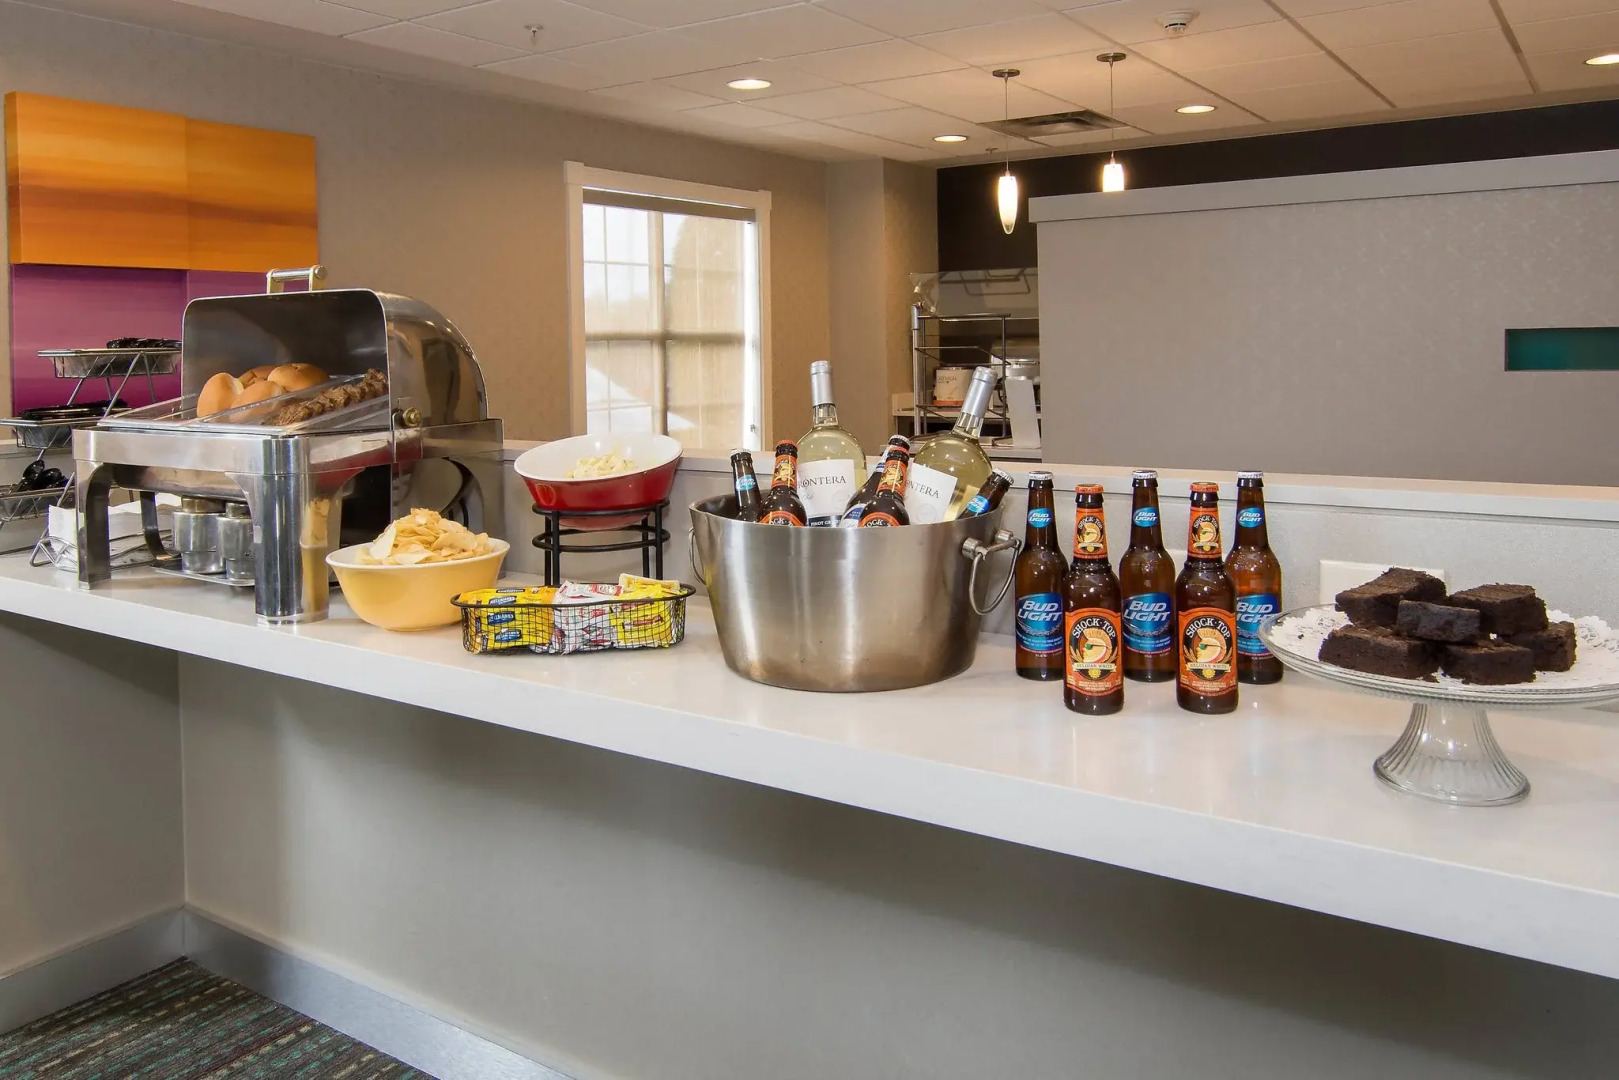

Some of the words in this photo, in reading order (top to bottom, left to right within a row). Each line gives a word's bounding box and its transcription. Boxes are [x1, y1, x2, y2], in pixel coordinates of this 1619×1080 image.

[798, 476, 846, 488] RONTERA
[1022, 600, 1059, 612] BUD
[1129, 600, 1167, 612] BUD
[1237, 602, 1273, 613] BUD
[1018, 609, 1062, 621] LIGHT
[1123, 609, 1170, 621] LIGHT
[1072, 618, 1099, 639] SHOCK
[1186, 618, 1214, 638] SHOCK
